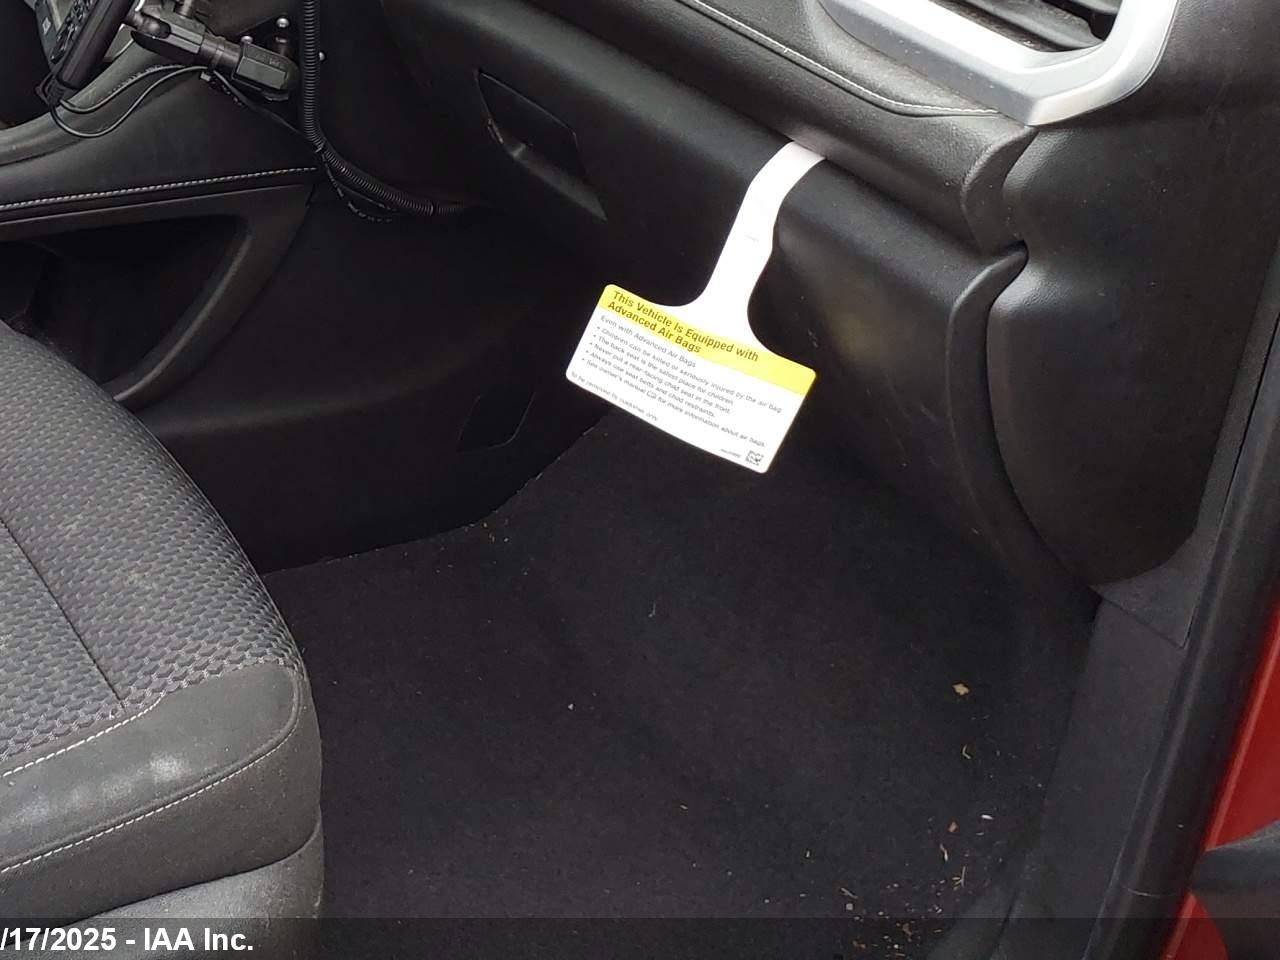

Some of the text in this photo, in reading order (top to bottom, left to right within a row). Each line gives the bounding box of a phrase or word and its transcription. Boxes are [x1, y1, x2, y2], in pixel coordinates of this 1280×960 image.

[601, 315, 617, 327] Even
[618, 325, 633, 335] with
[634, 333, 667, 353] Advanced
[679, 355, 696, 368] Bags
[608, 302, 701, 352] Advanced Air Bags
[614, 291, 634, 307] This
[637, 303, 672, 327] Vehicle
[685, 329, 734, 352] Equipped
[736, 348, 758, 361] with
